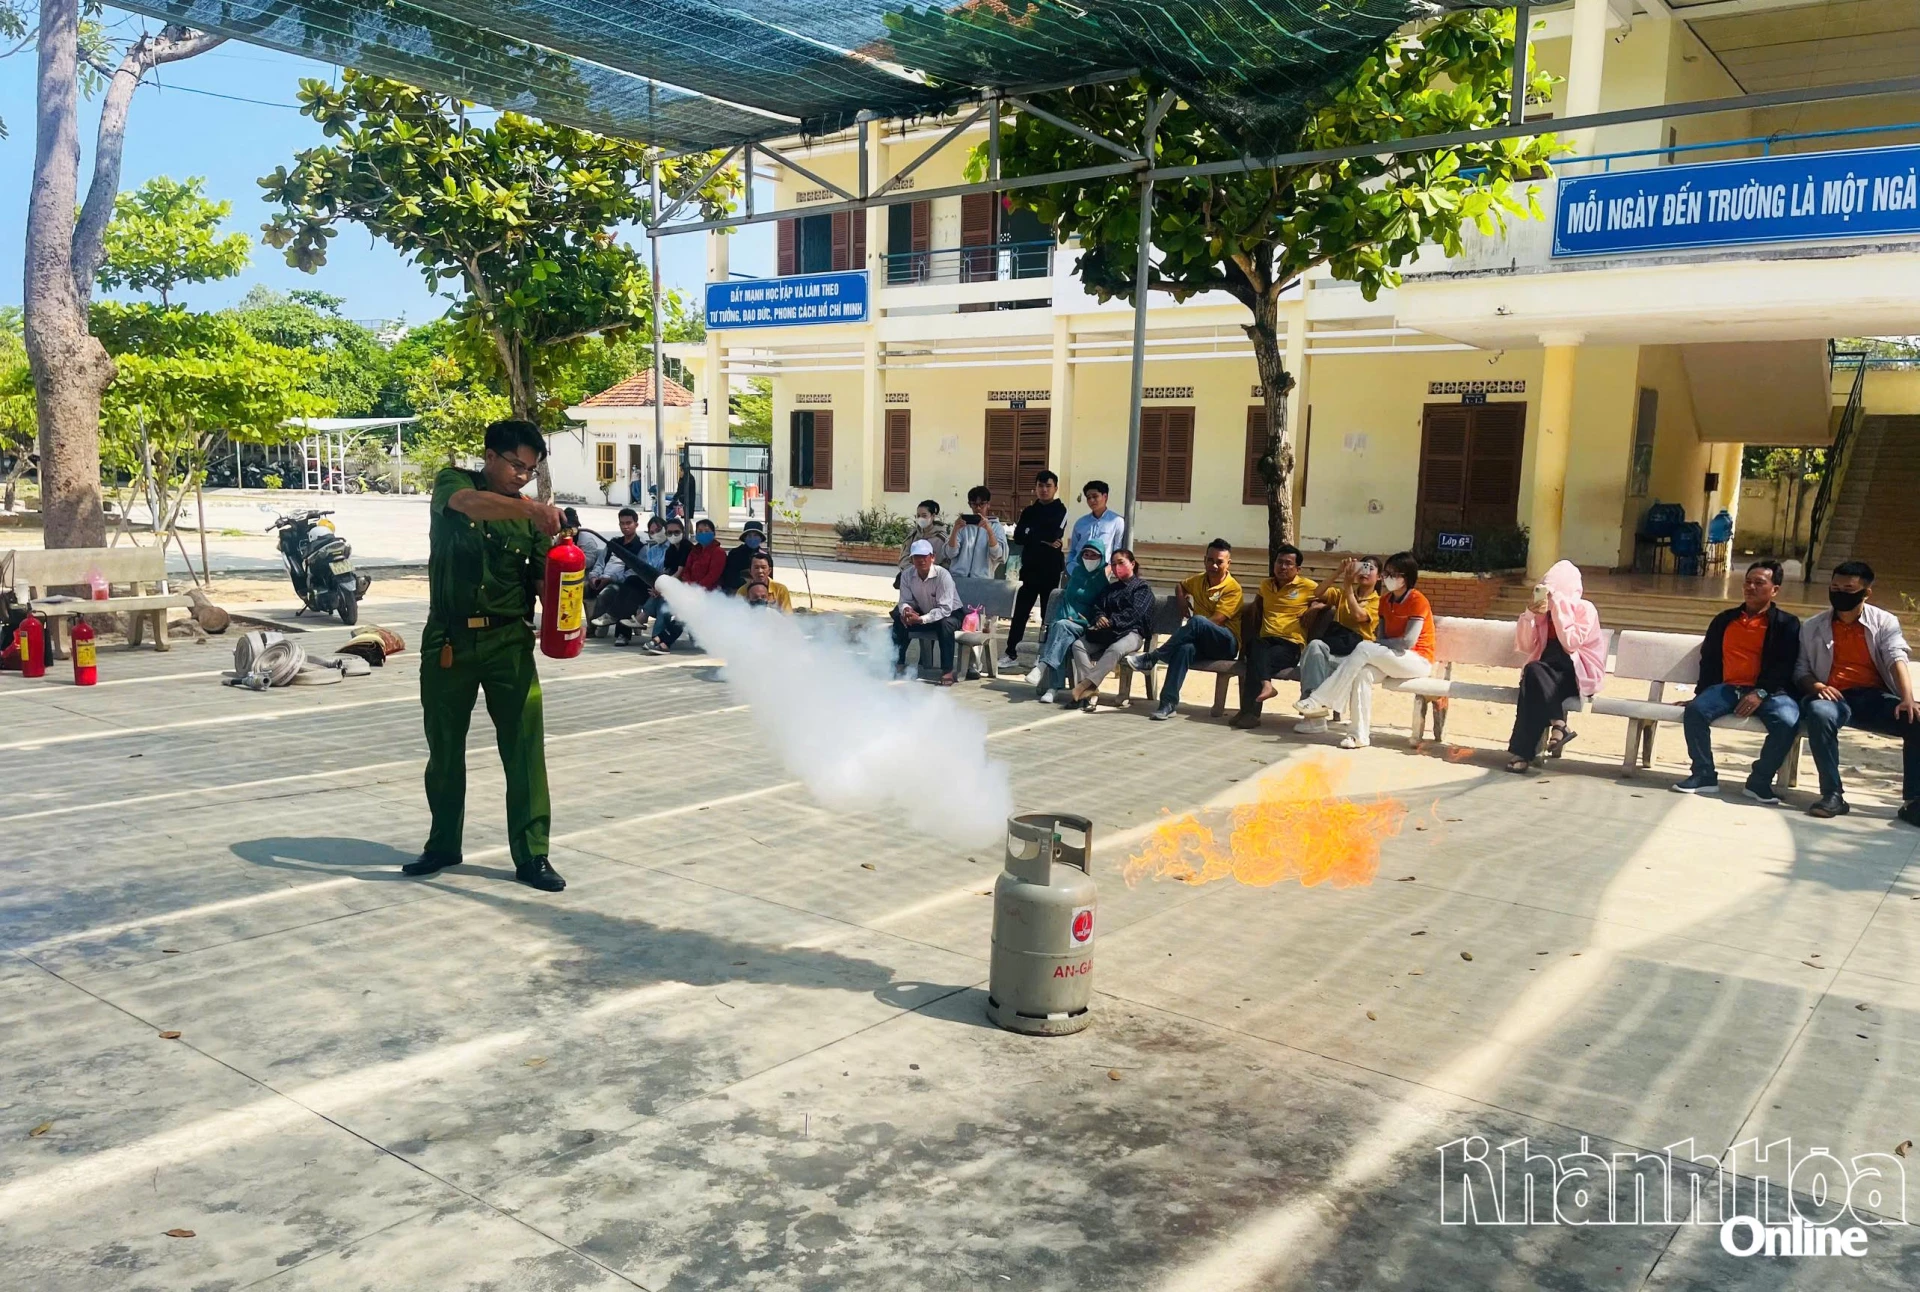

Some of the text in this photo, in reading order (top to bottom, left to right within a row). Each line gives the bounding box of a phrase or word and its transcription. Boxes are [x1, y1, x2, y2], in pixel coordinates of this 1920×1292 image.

[1567, 189, 1603, 234] MỖI
[1607, 189, 1659, 231] NGÀY
[1662, 181, 1702, 226] ĐẾN
[1707, 178, 1786, 222] TRƯỜNG
[1790, 175, 1815, 217] LÀ
[1821, 171, 1869, 221] MỘT
[744, 288, 764, 304] MẠNH
[765, 287, 779, 303] HỌC
[780, 284, 793, 302] TẬP
[794, 283, 804, 298] VÀ
[805, 282, 820, 298] LÀM
[821, 283, 839, 297] THEO
[710, 310, 719, 323] TƯ
[742, 308, 756, 324] ĐẠO
[774, 306, 797, 320] PHONG
[798, 303, 817, 318] CÁCH
[829, 301, 842, 317] CHÍ
[843, 302, 863, 316] MINH
[1053, 957, 1094, 978] AN-GA
